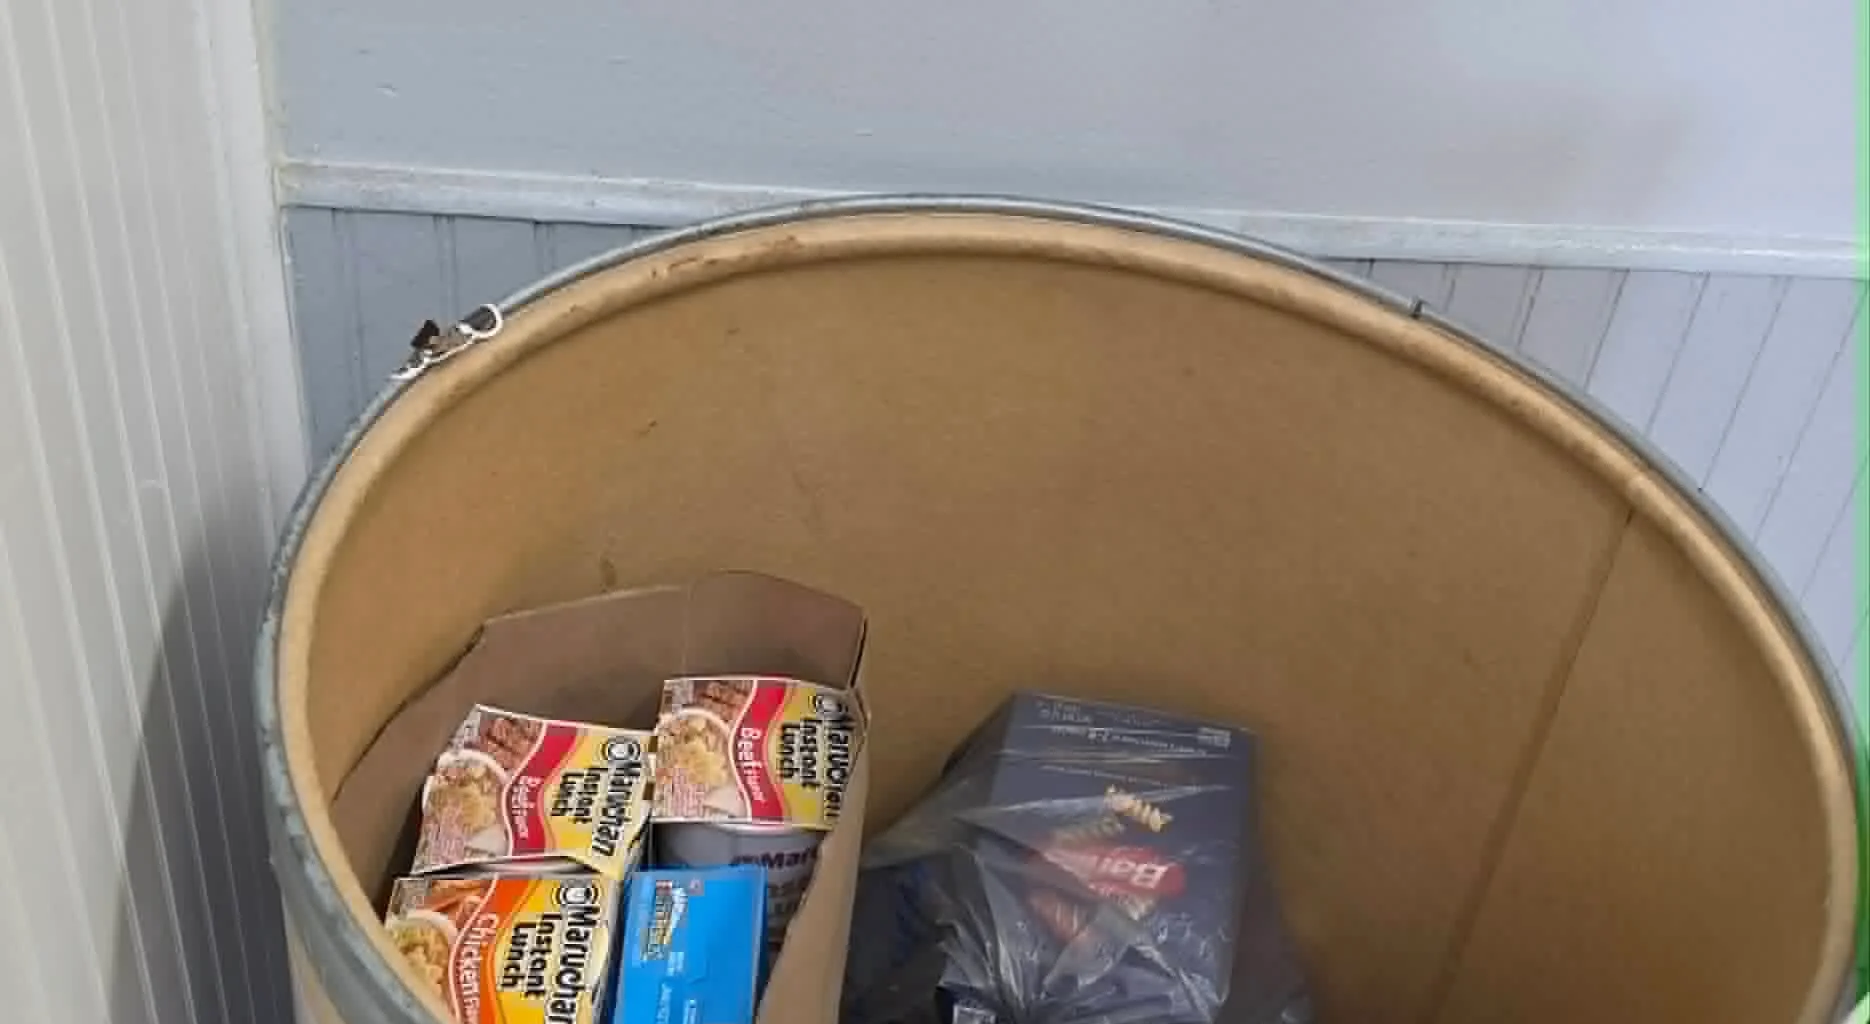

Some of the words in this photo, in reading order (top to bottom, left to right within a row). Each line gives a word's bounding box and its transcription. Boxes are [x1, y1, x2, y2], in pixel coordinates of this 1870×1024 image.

[777, 723, 800, 778] Lunch
[801, 717, 822, 788] Instant
[551, 772, 588, 816] Lunch
[568, 767, 609, 823] Instant
[592, 760, 641, 856] Maruchan
[461, 912, 498, 998] Chicken
[501, 922, 537, 988] Lunch
[524, 913, 562, 998] Instant
